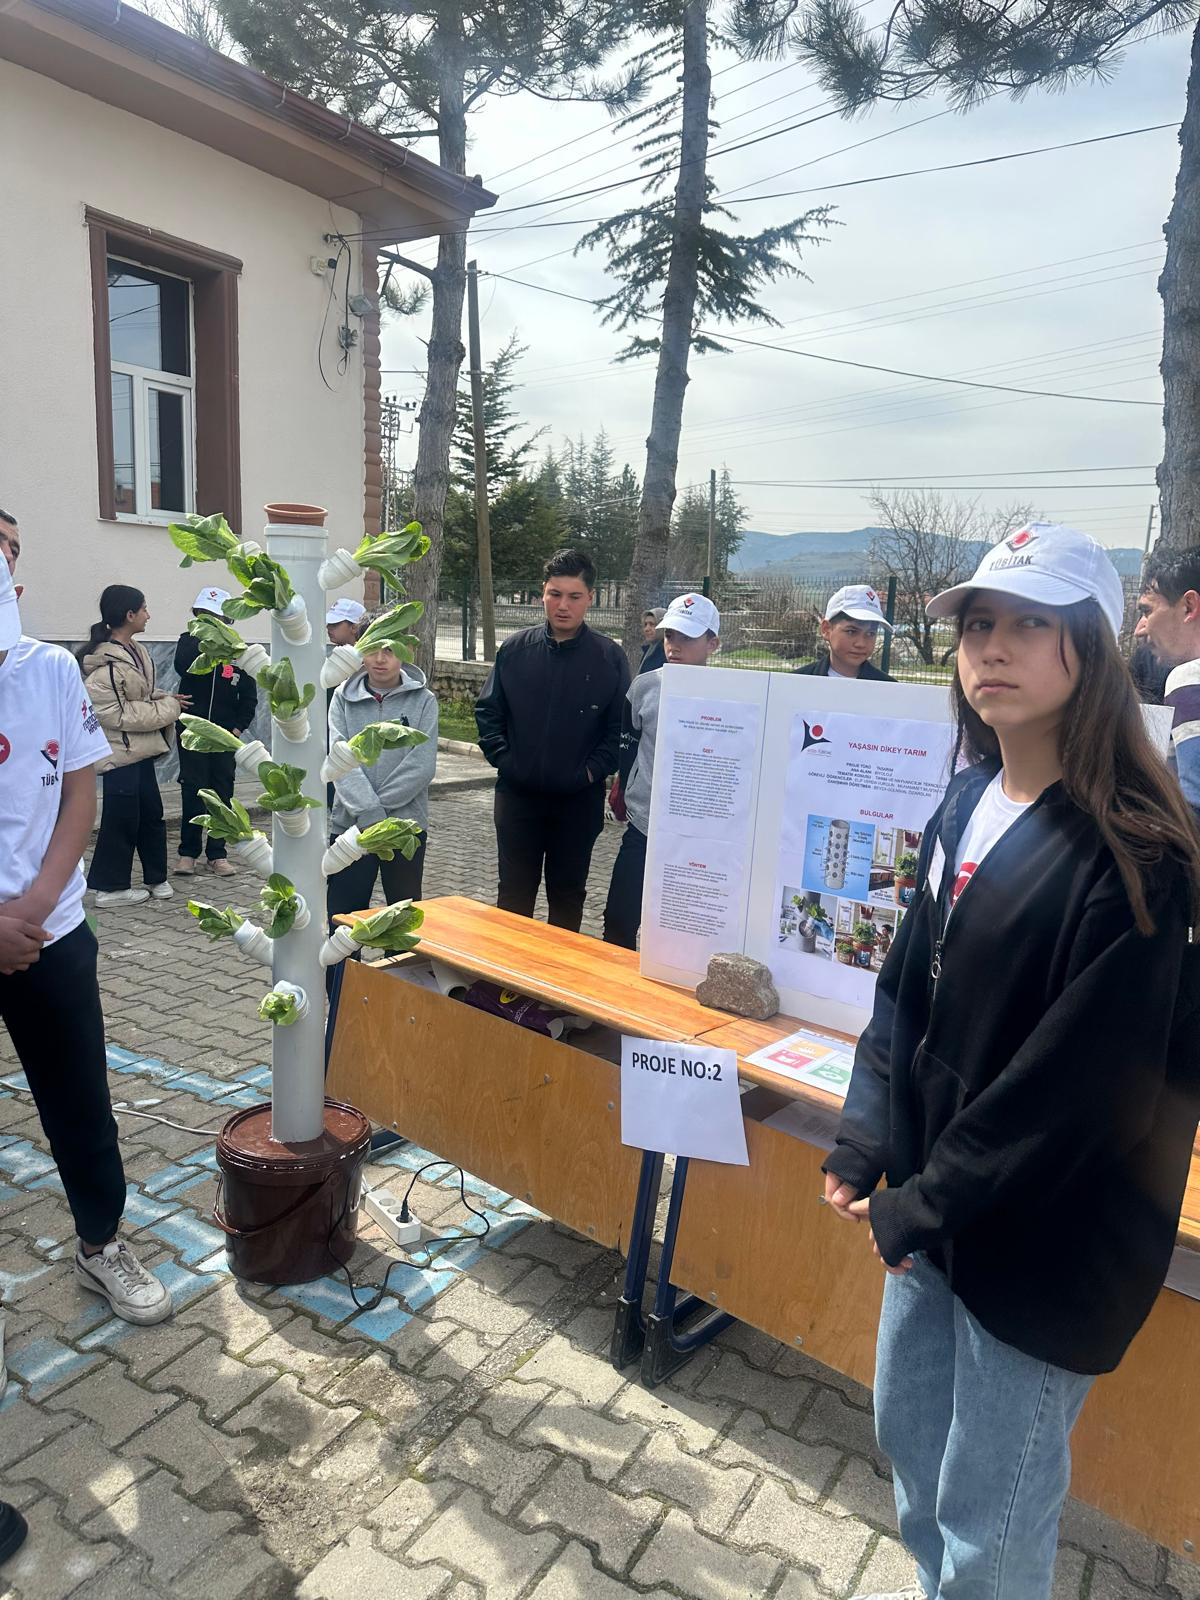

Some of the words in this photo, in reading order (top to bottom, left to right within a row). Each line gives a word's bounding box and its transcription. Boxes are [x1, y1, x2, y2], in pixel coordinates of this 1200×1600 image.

[989, 555, 1034, 571] TÜBİTAK
[848, 742, 879, 751] YAŞASIN
[880, 745, 902, 754] DİKEY
[904, 748, 927, 757] TARIM
[860, 809, 894, 819] BULGULAR
[632, 1052, 676, 1075] PROJE
[681, 1060, 722, 1081] NO:2
